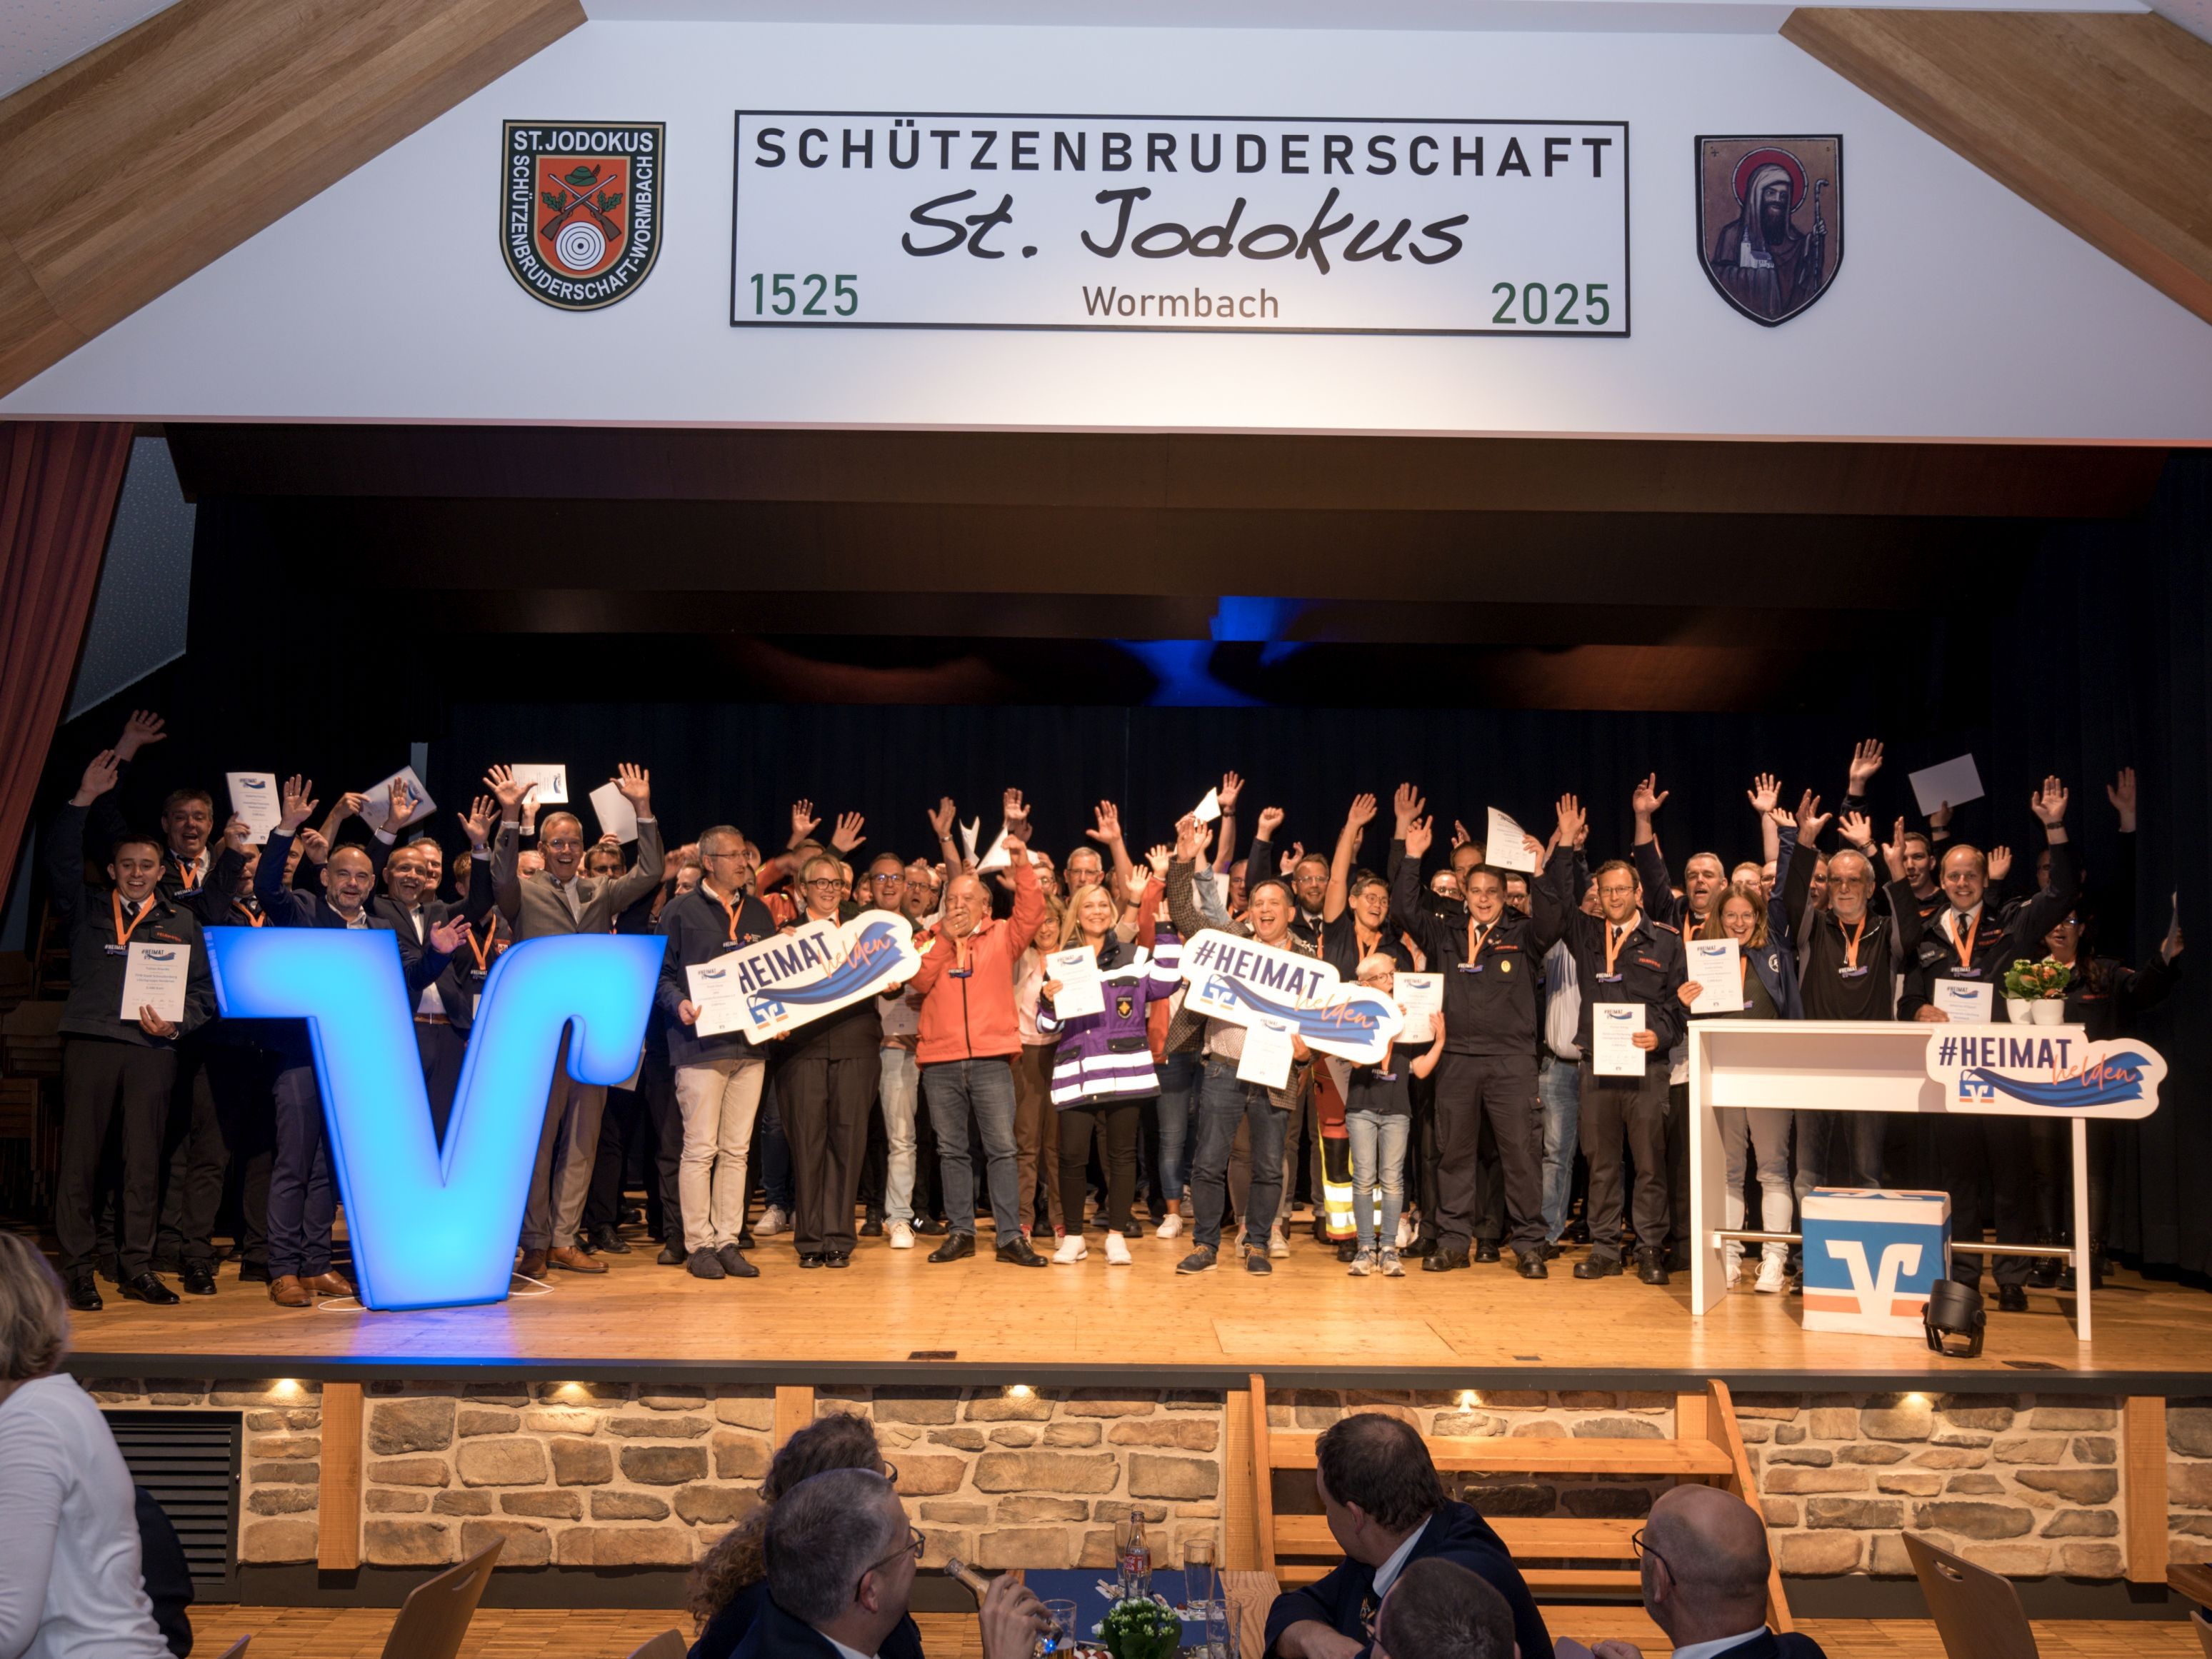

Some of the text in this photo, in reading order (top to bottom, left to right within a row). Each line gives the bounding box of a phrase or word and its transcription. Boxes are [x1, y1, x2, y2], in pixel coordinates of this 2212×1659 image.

[754, 119, 1612, 178] SCHÜTZENBRUDERSCHAFT
[901, 186, 1469, 275] St. Jodokus
[751, 273, 859, 316] 1525
[1082, 286, 1279, 319] Wormbach
[1491, 281, 1611, 326] 2025
[817, 933, 890, 978] helden
[1193, 940, 1324, 999] #HEIMAT
[1294, 984, 1374, 1028] helden
[1938, 1036, 2136, 1091] #HEIMAT helden
